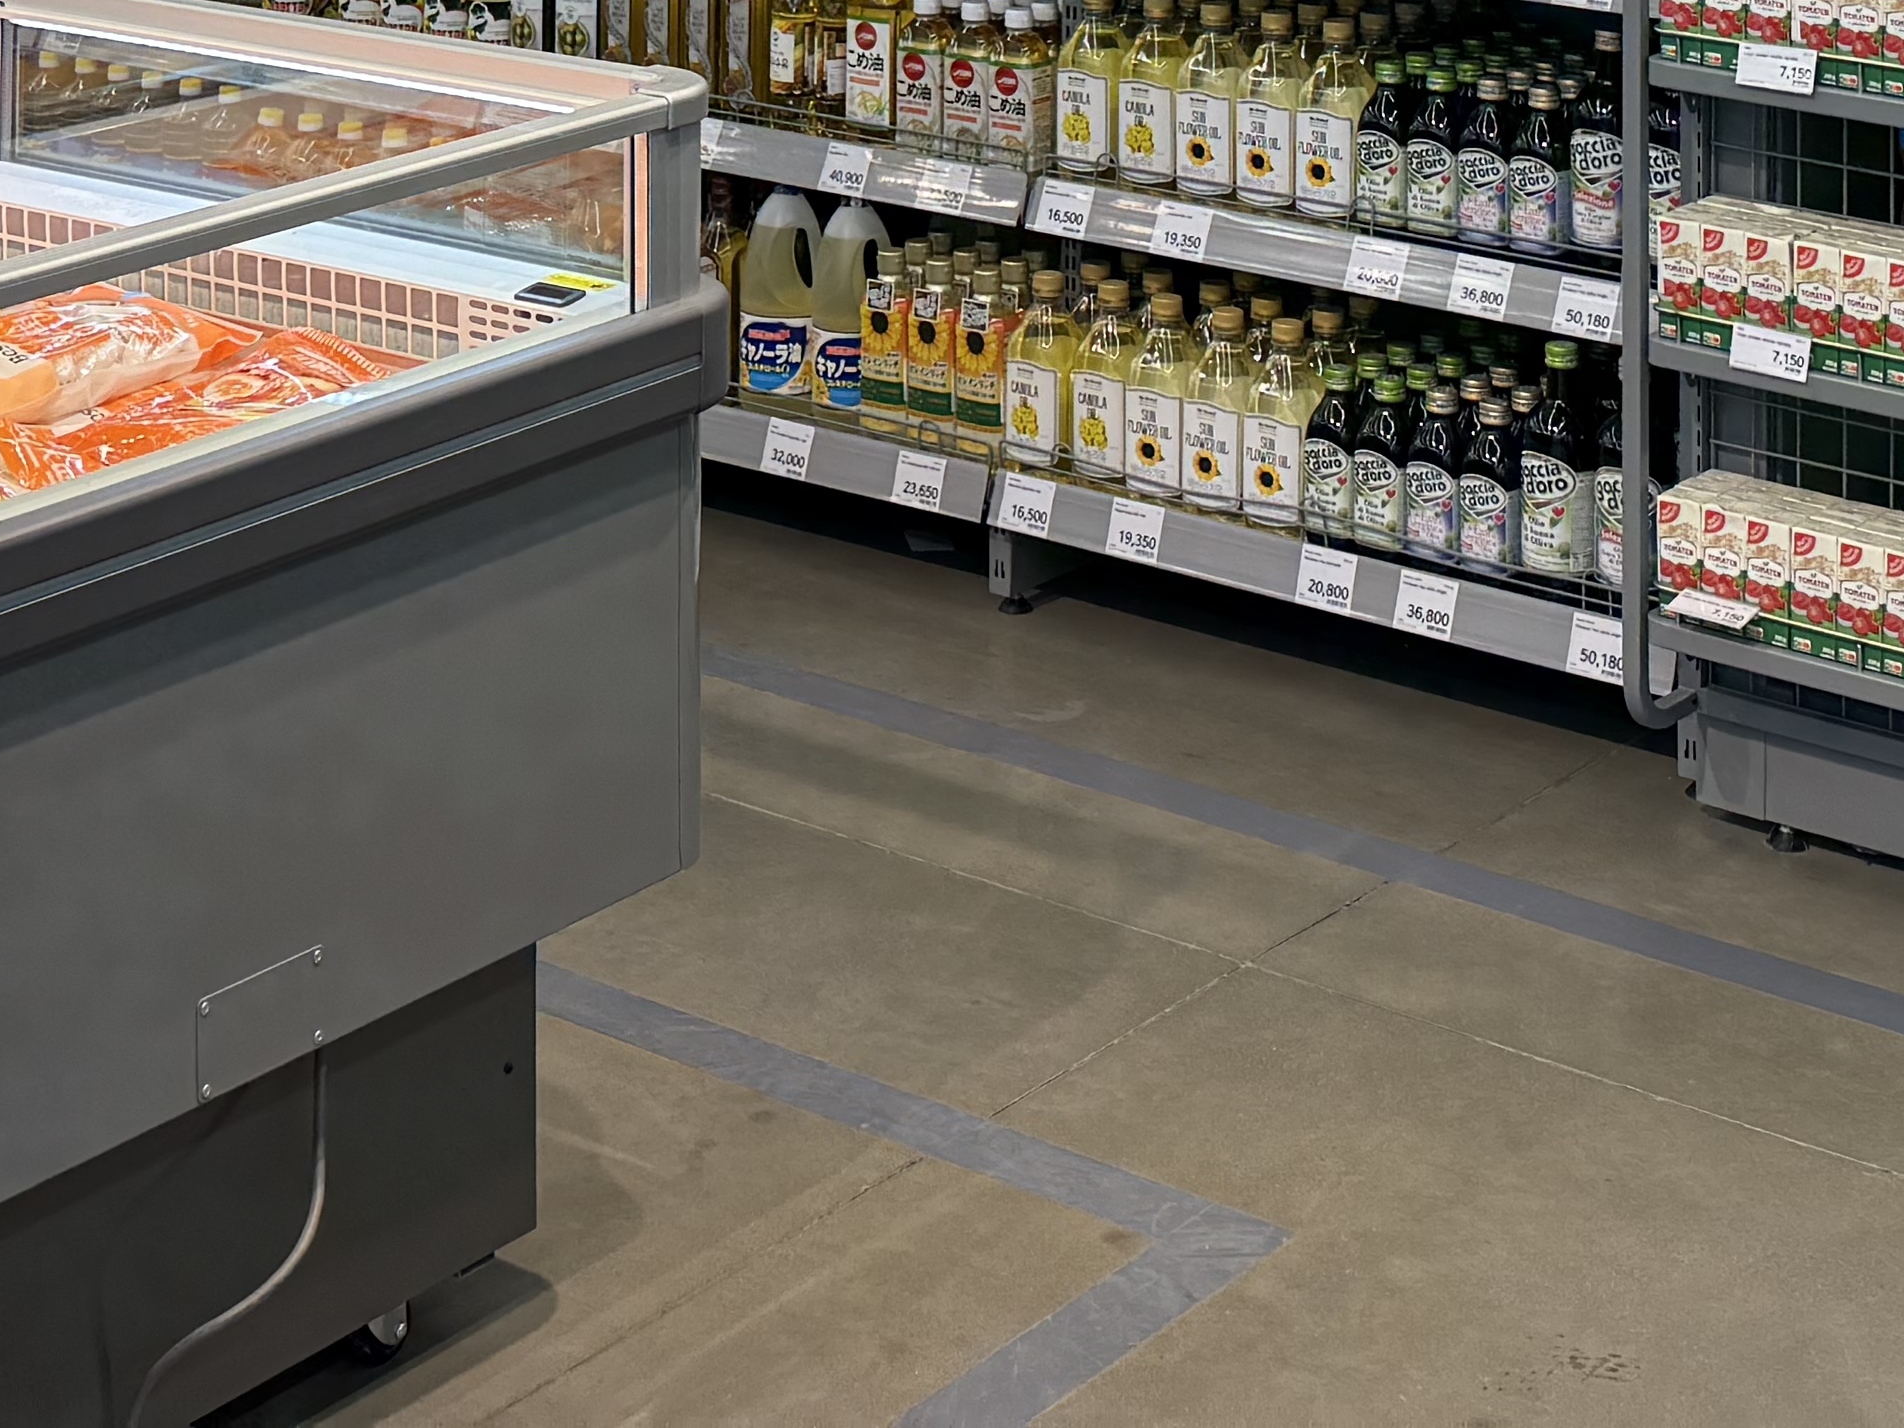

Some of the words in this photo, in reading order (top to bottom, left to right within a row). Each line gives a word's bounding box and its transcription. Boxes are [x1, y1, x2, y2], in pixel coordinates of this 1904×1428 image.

[1779, 63, 1813, 81] 7,150
[1125, 99, 1155, 117] CANOLA
[1047, 208, 1085, 227] 16,500
[1162, 229, 1202, 249] 19,350
[1663, 261, 1695, 278] TOMATEN
[1706, 271, 1739, 286] TOMATEN
[1459, 285, 1504, 307] 36,800
[1750, 280, 1784, 294] TOMATEN
[1800, 288, 1834, 303] TOMATEN
[1846, 298, 1880, 314] TOMATEN
[1564, 308, 1610, 331] 50,180
[1771, 349, 1806, 369] 7,150
[771, 448, 806, 470] 32,000
[902, 479, 939, 501] 23,650
[1011, 504, 1049, 525] 16,500
[1117, 529, 1157, 551] 19,350
[1662, 542, 1694, 558] TOMATEN
[1750, 562, 1784, 578] TOMATEN
[1306, 577, 1350, 601] 20,800
[1843, 587, 1877, 603] TOMATEN
[1405, 602, 1451, 627] 36,800
